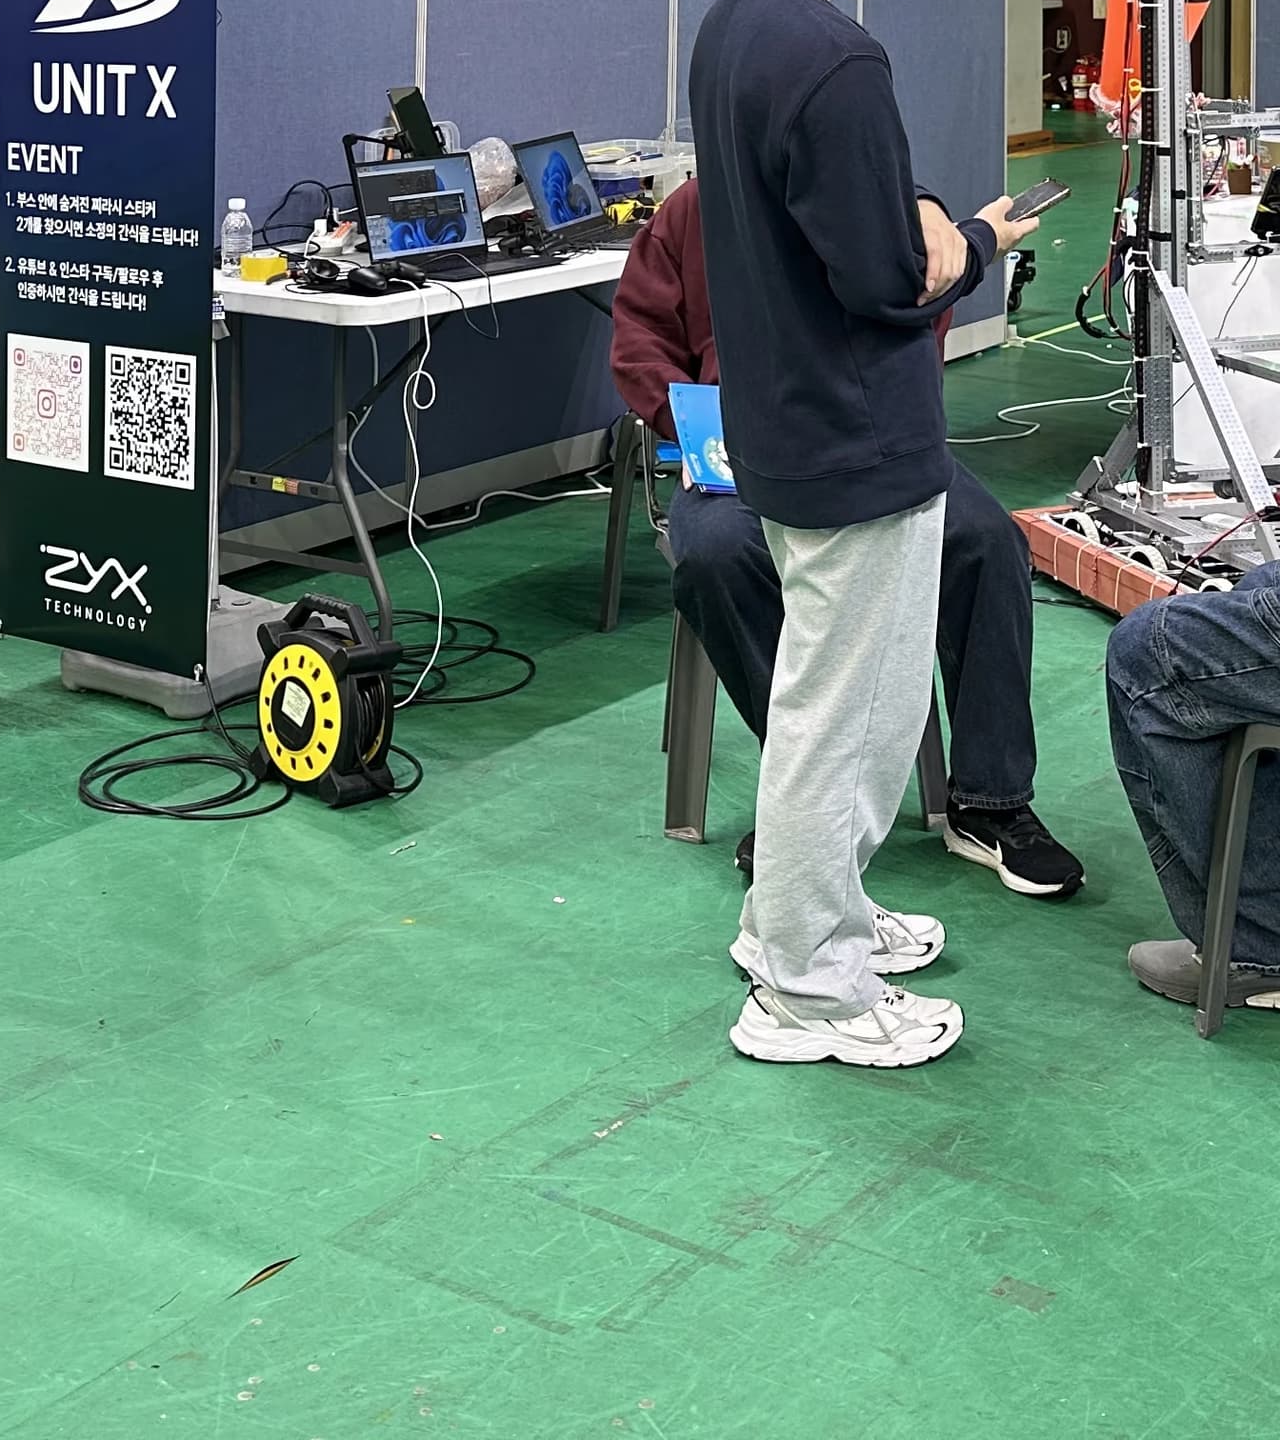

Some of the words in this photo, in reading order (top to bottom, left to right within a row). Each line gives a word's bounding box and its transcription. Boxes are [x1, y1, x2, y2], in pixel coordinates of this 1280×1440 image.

[33, 62, 136, 116] UNIT
[145, 65, 177, 118] X
[7, 142, 83, 174] EVENT
[6, 192, 15, 207] 1.
[17, 192, 37, 208] 부스
[38, 193, 58, 210] 안에
[59, 195, 89, 213] 숨겨진
[124, 200, 156, 218] 스티커
[16, 216, 42, 234] 2개를
[44, 217, 83, 238] 찾으시면
[85, 221, 116, 240] 소정의
[118, 223, 149, 243] 간식을
[151, 227, 199, 247] 드립니다!
[5, 257, 16, 273] 2.
[17, 257, 47, 275] 유튜브
[49, 261, 57, 275] &
[59, 262, 90, 280] 인스타
[92, 265, 149, 286] 구독/팔로우
[152, 270, 164, 288] 후
[17, 281, 66, 303] 인증하시면
[68, 287, 99, 307] 간식을
[100, 291, 147, 311] 드립니다!
[39, 544, 152, 614] ZYX
[44, 597, 147, 633] TECHNOLOGY
